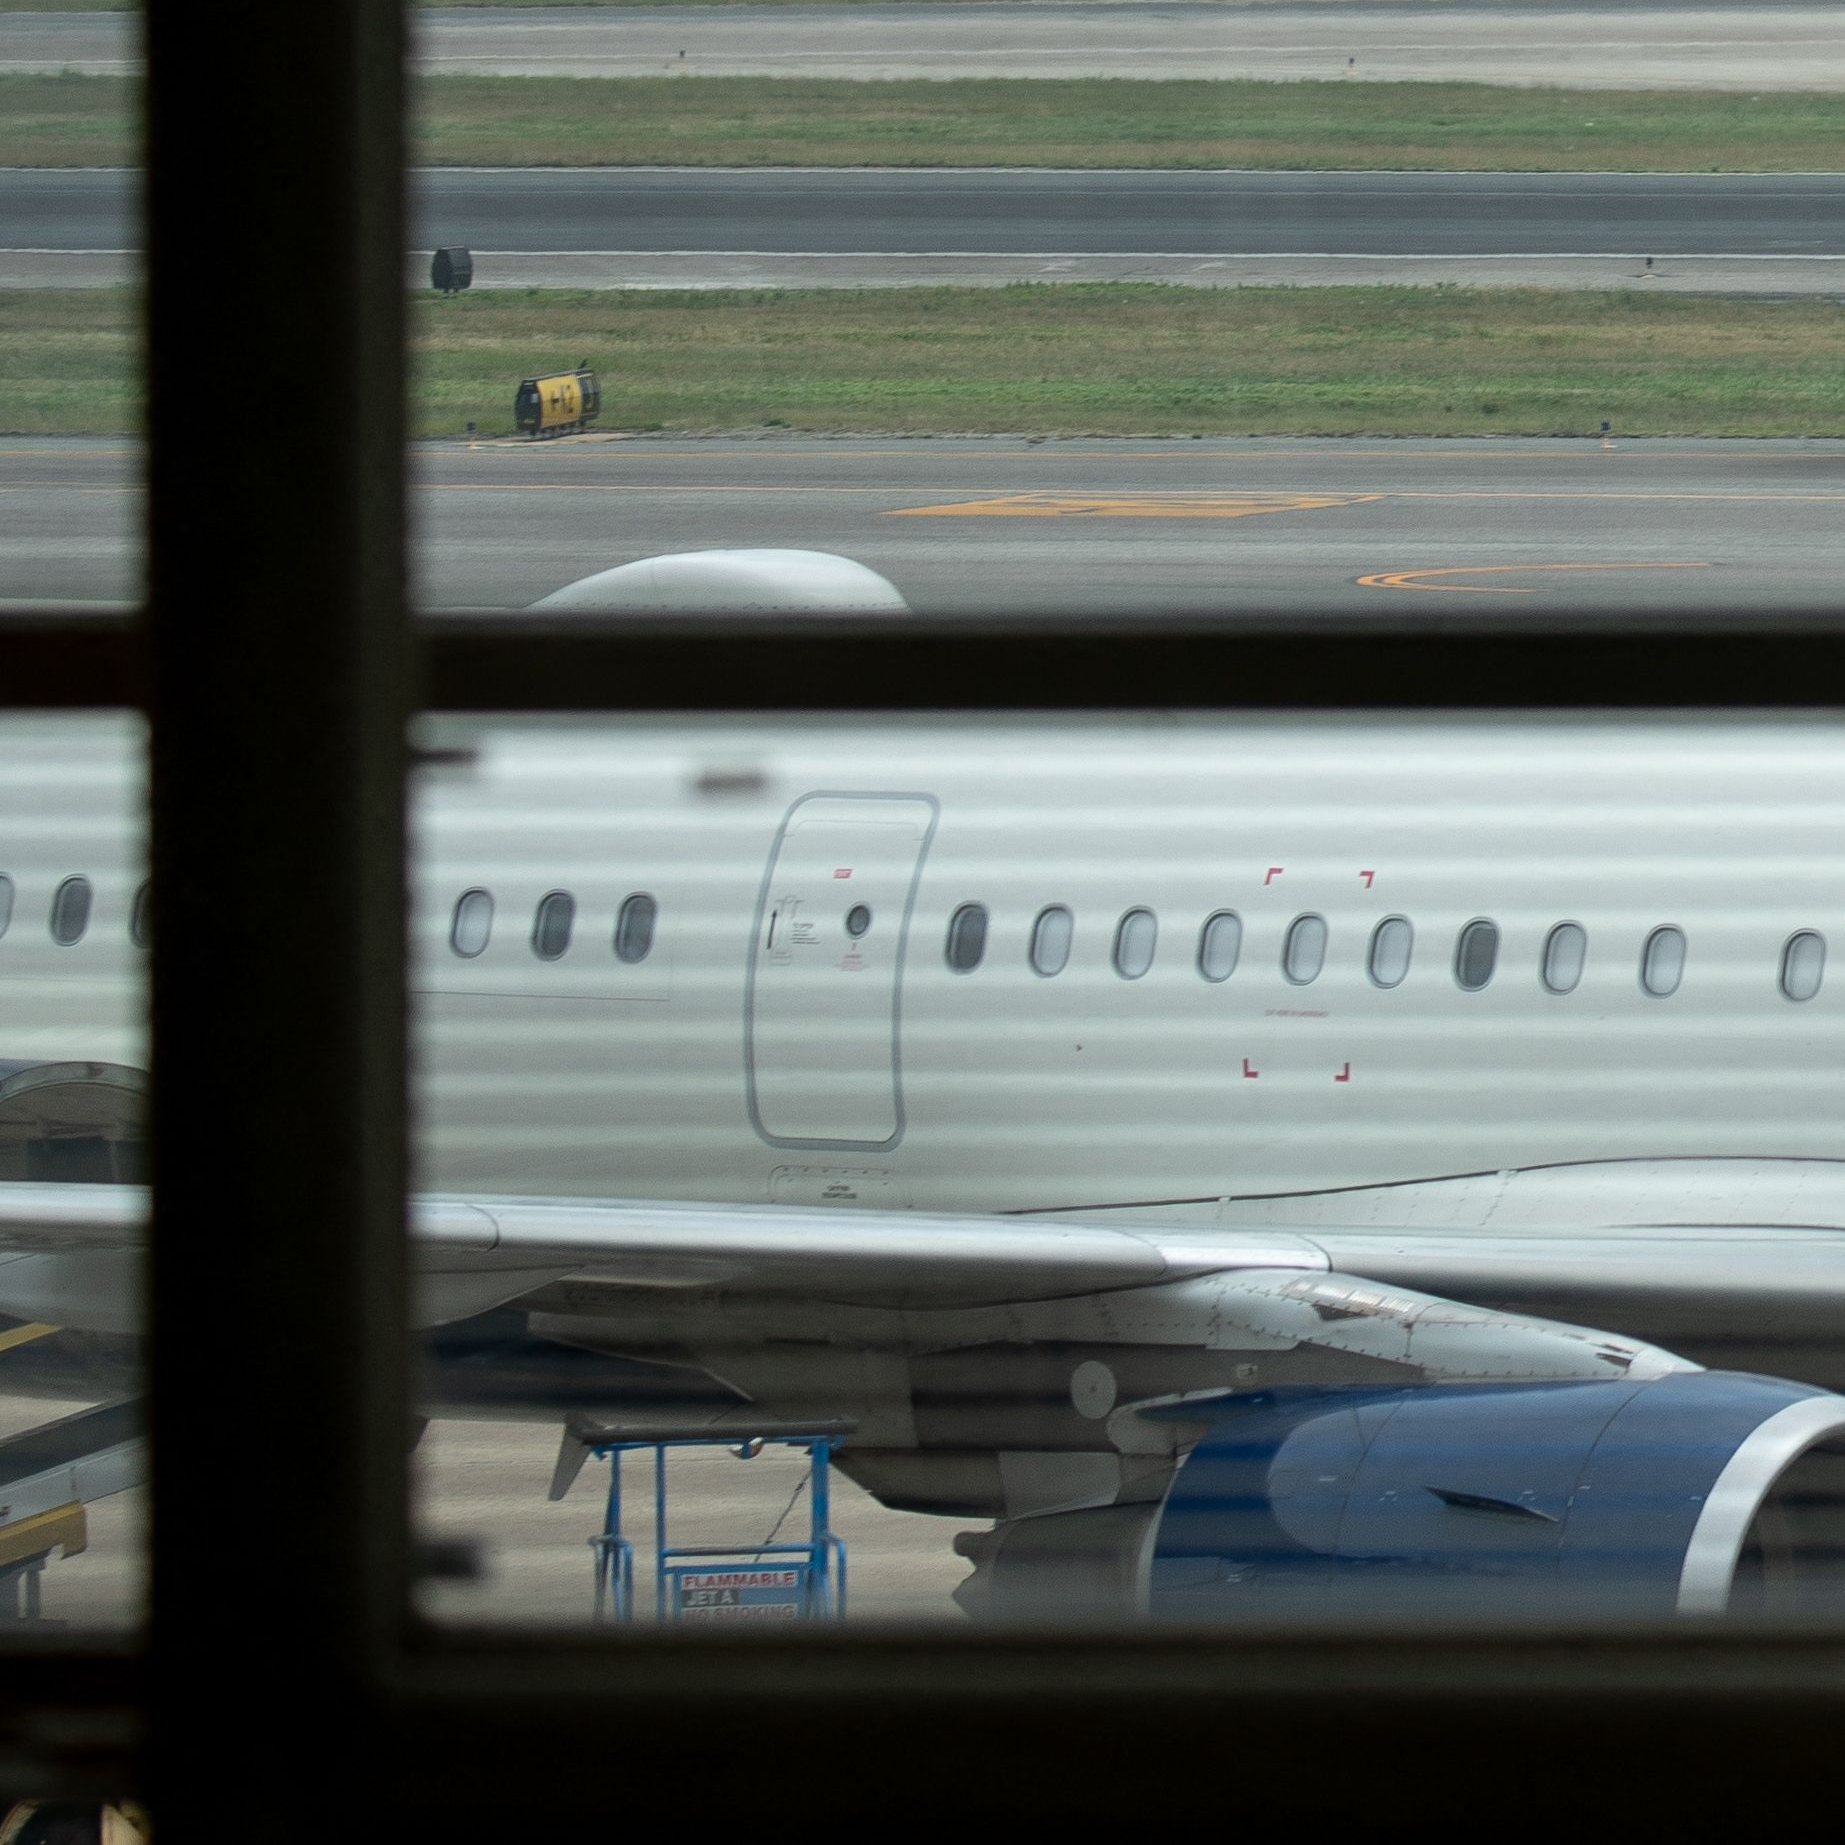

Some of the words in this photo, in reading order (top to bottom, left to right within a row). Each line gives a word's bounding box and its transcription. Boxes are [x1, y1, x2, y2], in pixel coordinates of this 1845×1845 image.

[684, 1571, 796, 1589] FLAMMABLE
[686, 1590, 716, 1607] JET
[719, 1589, 735, 1605] A
